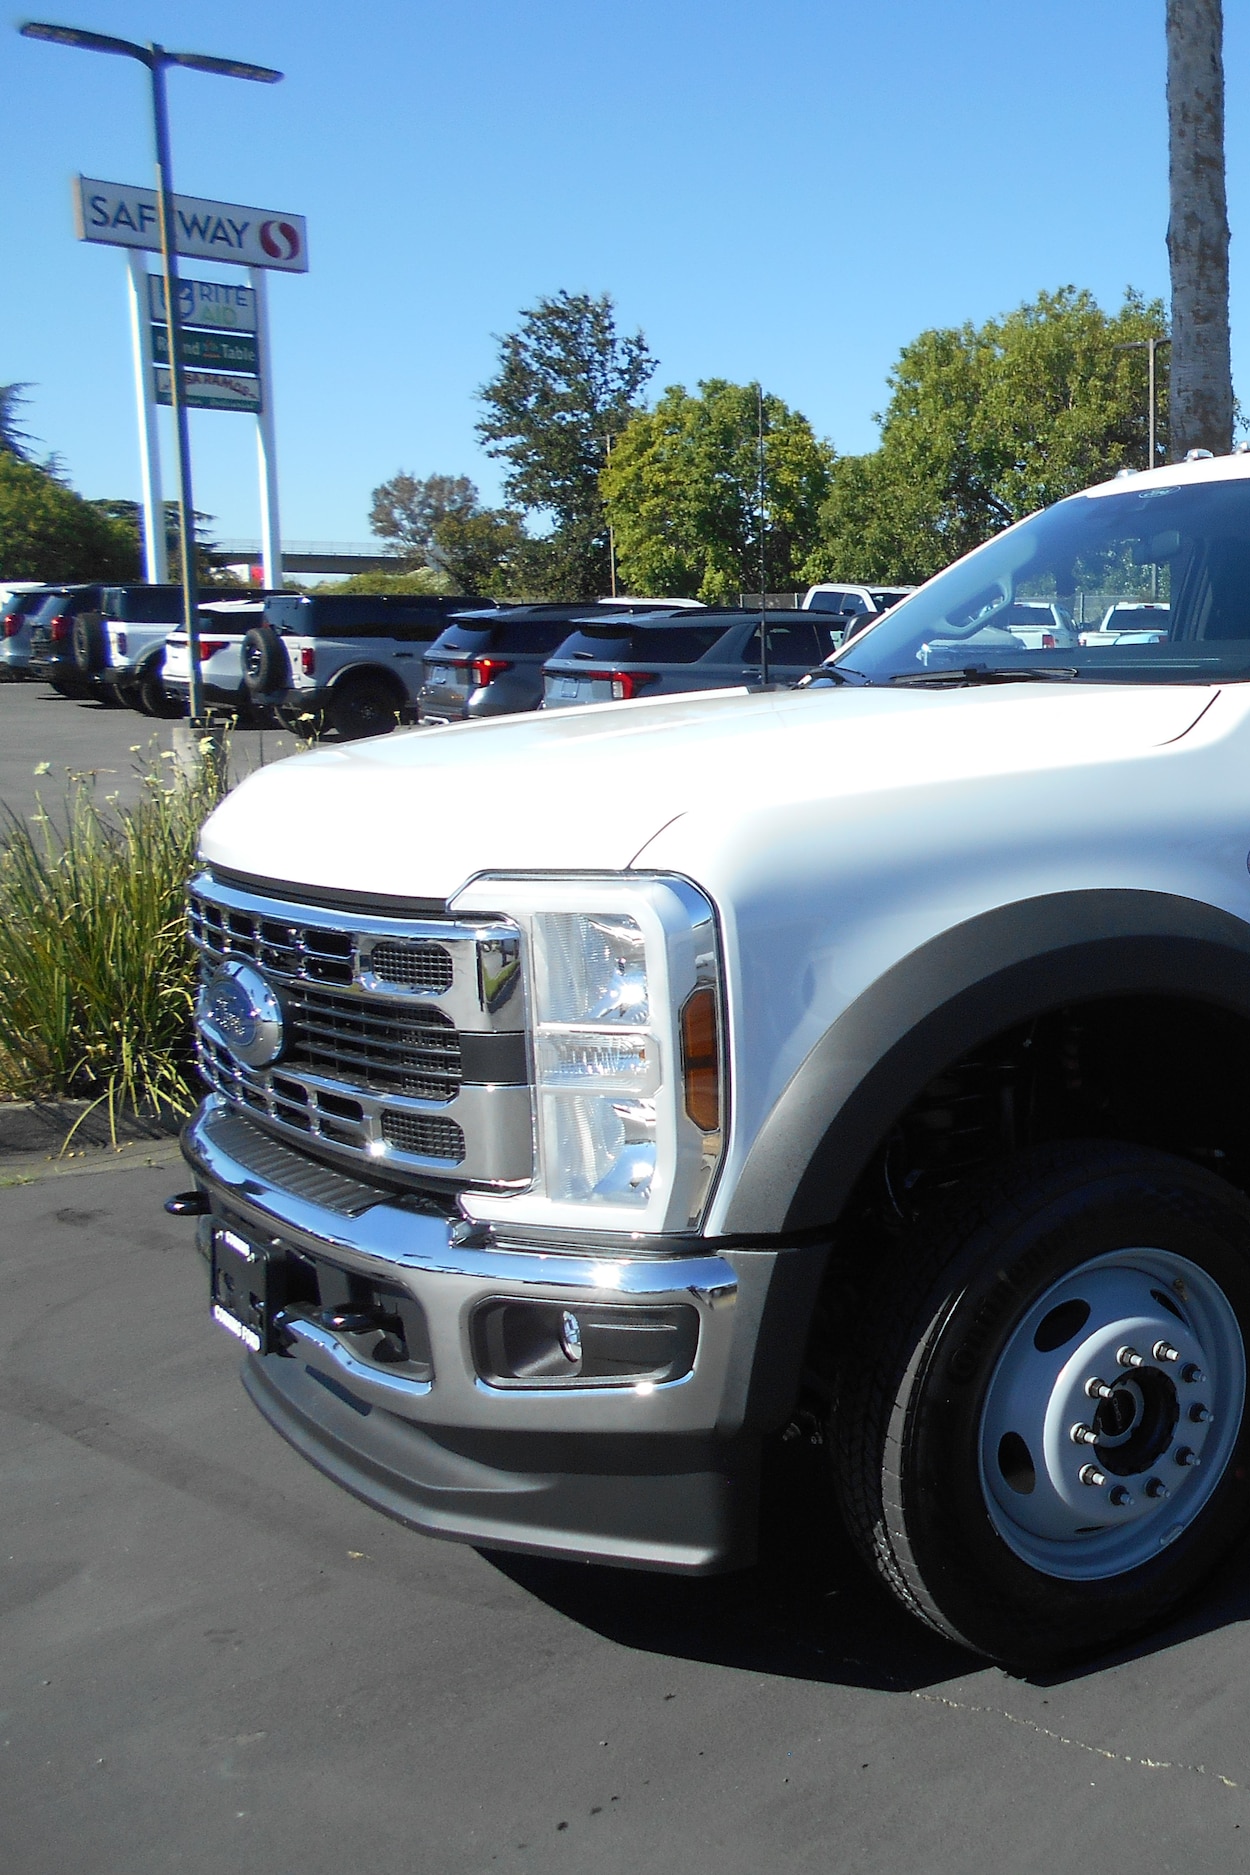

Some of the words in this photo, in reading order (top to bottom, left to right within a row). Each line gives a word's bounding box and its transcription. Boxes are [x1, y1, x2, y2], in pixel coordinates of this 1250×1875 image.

[91, 196, 249, 248] SAFWAY
[200, 284, 247, 306] RITE
[203, 306, 237, 326] AID
[222, 343, 256, 361] Table
